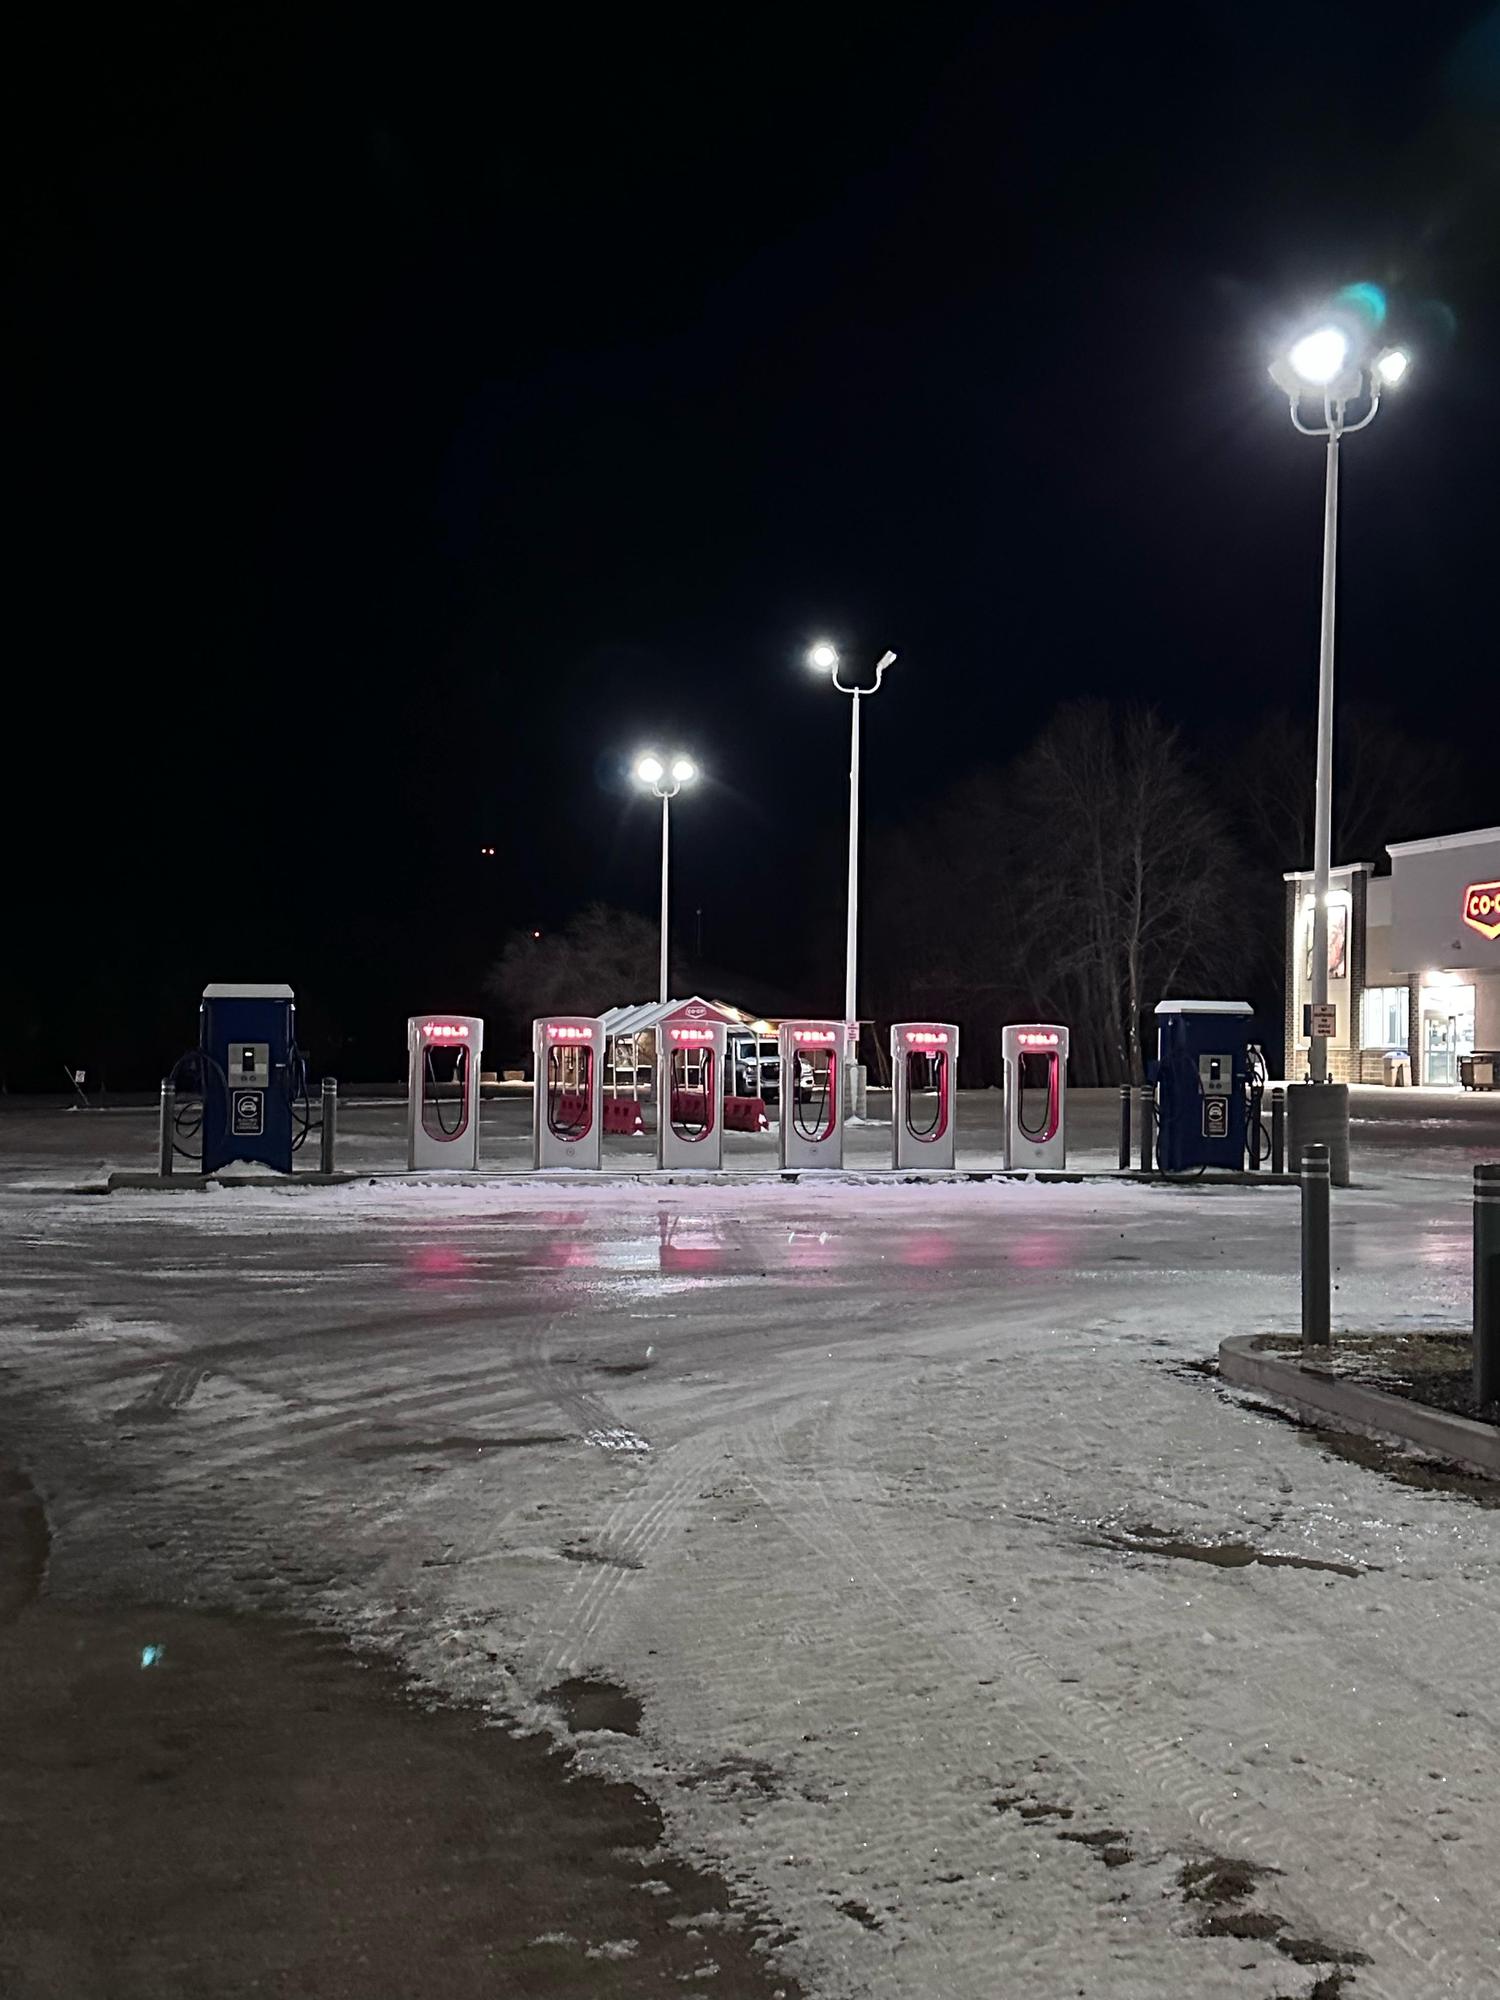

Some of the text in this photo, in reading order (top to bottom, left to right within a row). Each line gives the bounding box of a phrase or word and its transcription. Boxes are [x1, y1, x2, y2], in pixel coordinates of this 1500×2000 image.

[423, 1026, 469, 1037] TESLA
[549, 1027, 592, 1038] TESLA
[671, 1029, 714, 1040] TESLA
[794, 1030, 836, 1041] TESLA
[905, 1032, 948, 1043] TESLA
[1018, 1033, 1058, 1044] TESLA
